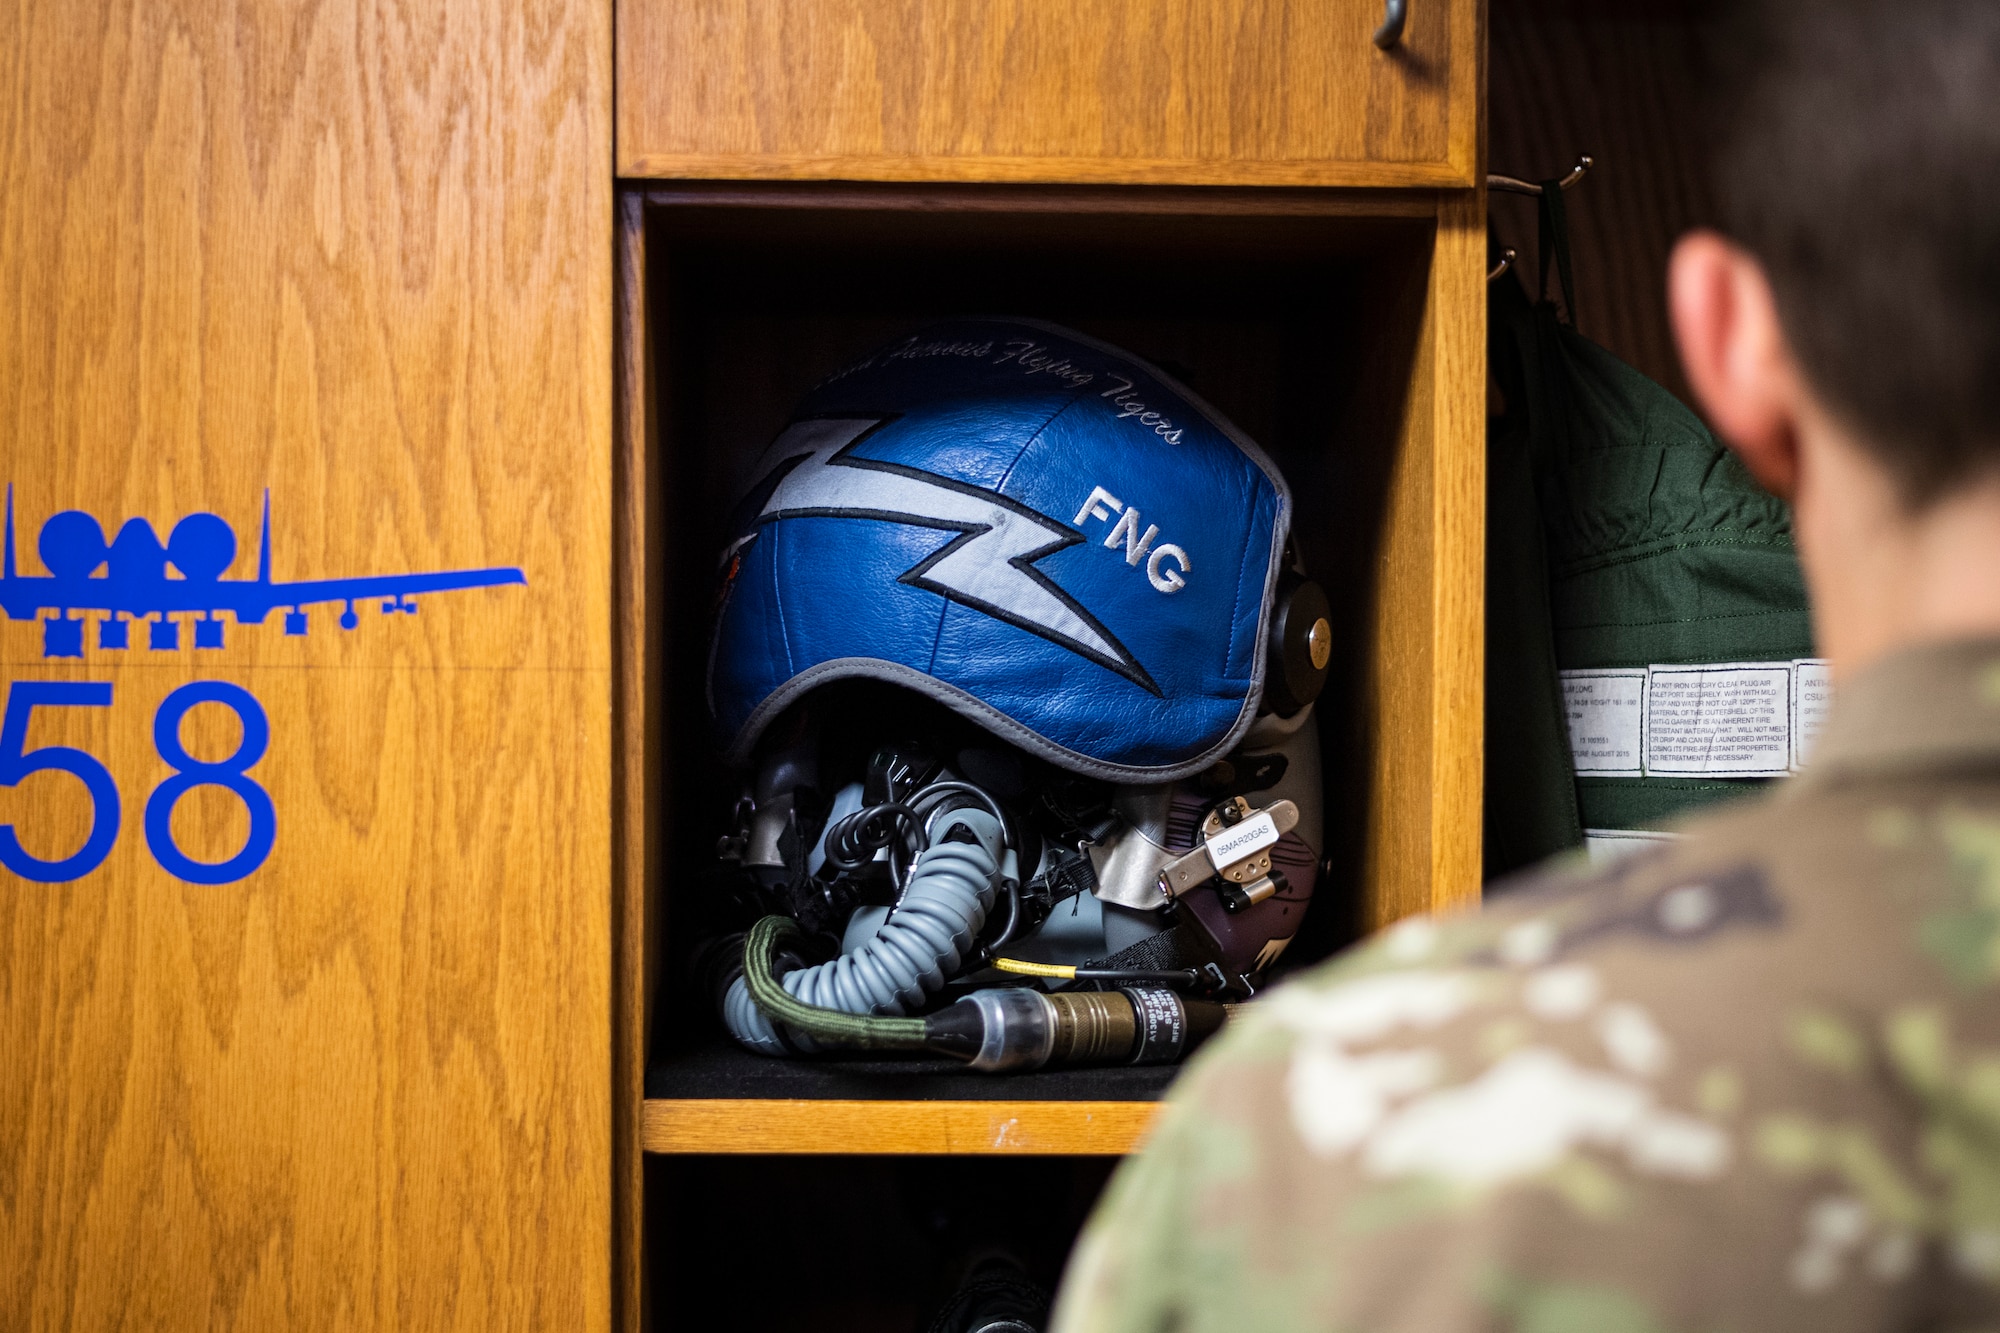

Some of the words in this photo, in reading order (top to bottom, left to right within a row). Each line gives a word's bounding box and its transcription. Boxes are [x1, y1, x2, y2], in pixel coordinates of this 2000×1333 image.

[993, 339, 1094, 389] Flying
[1099, 371, 1184, 446] Tigers
[1072, 485, 1191, 595] FNG
[1576, 685, 1593, 693] LONG
[0, 680, 277, 885] 58
[1216, 824, 1269, 856] 05MAR20GAS
[1164, 1011, 1172, 1024] SN
[1171, 1019, 1179, 1042] MFR:
